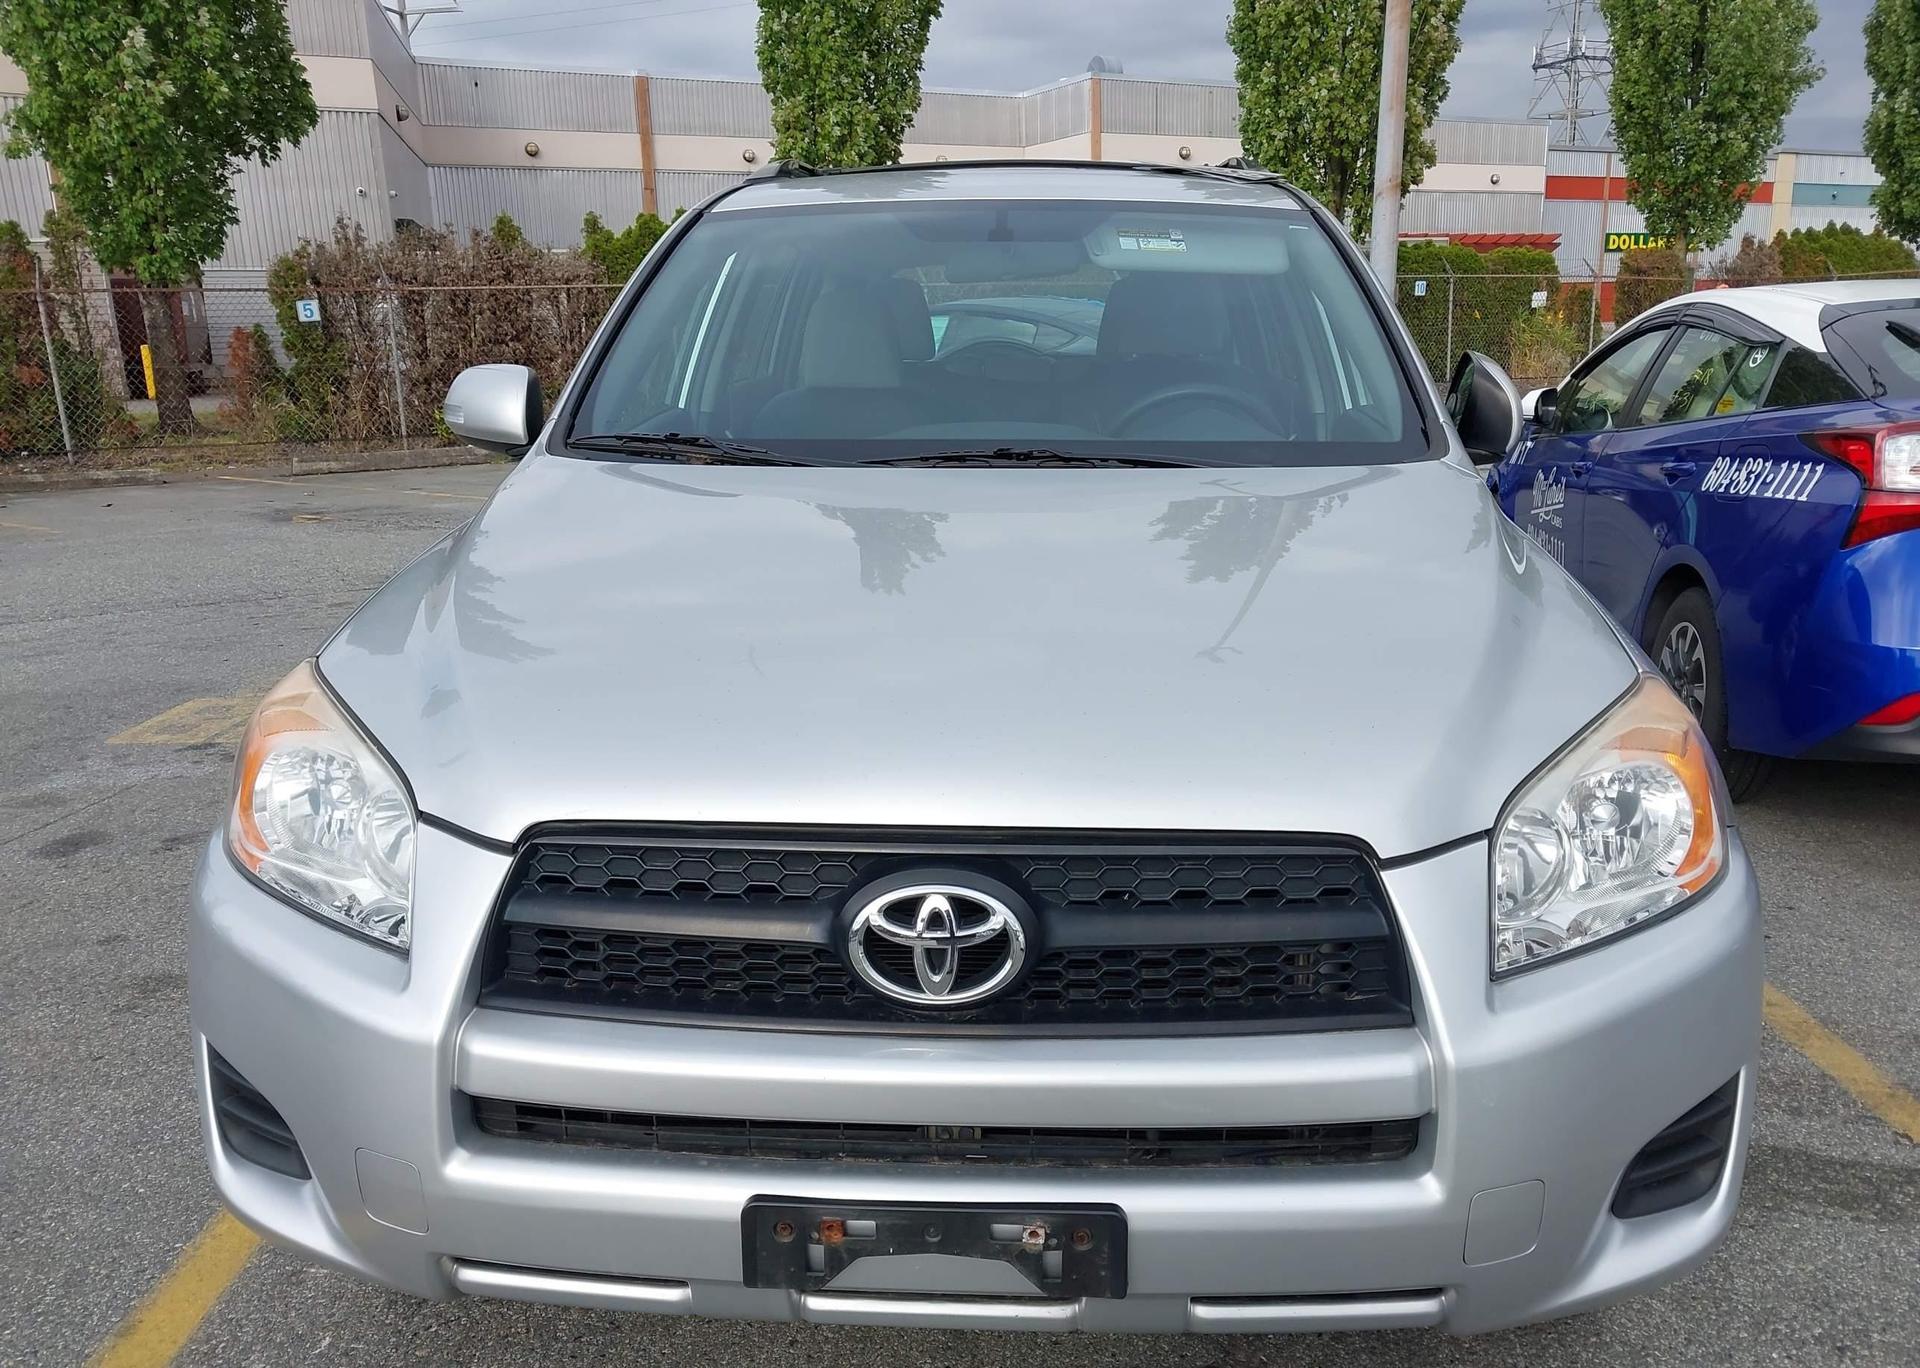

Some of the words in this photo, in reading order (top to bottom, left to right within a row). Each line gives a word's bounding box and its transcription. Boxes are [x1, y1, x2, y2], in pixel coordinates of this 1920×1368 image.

[1609, 234, 1665, 249] DOLLAR
[1416, 282, 1425, 294] 10
[303, 303, 314, 318] 5
